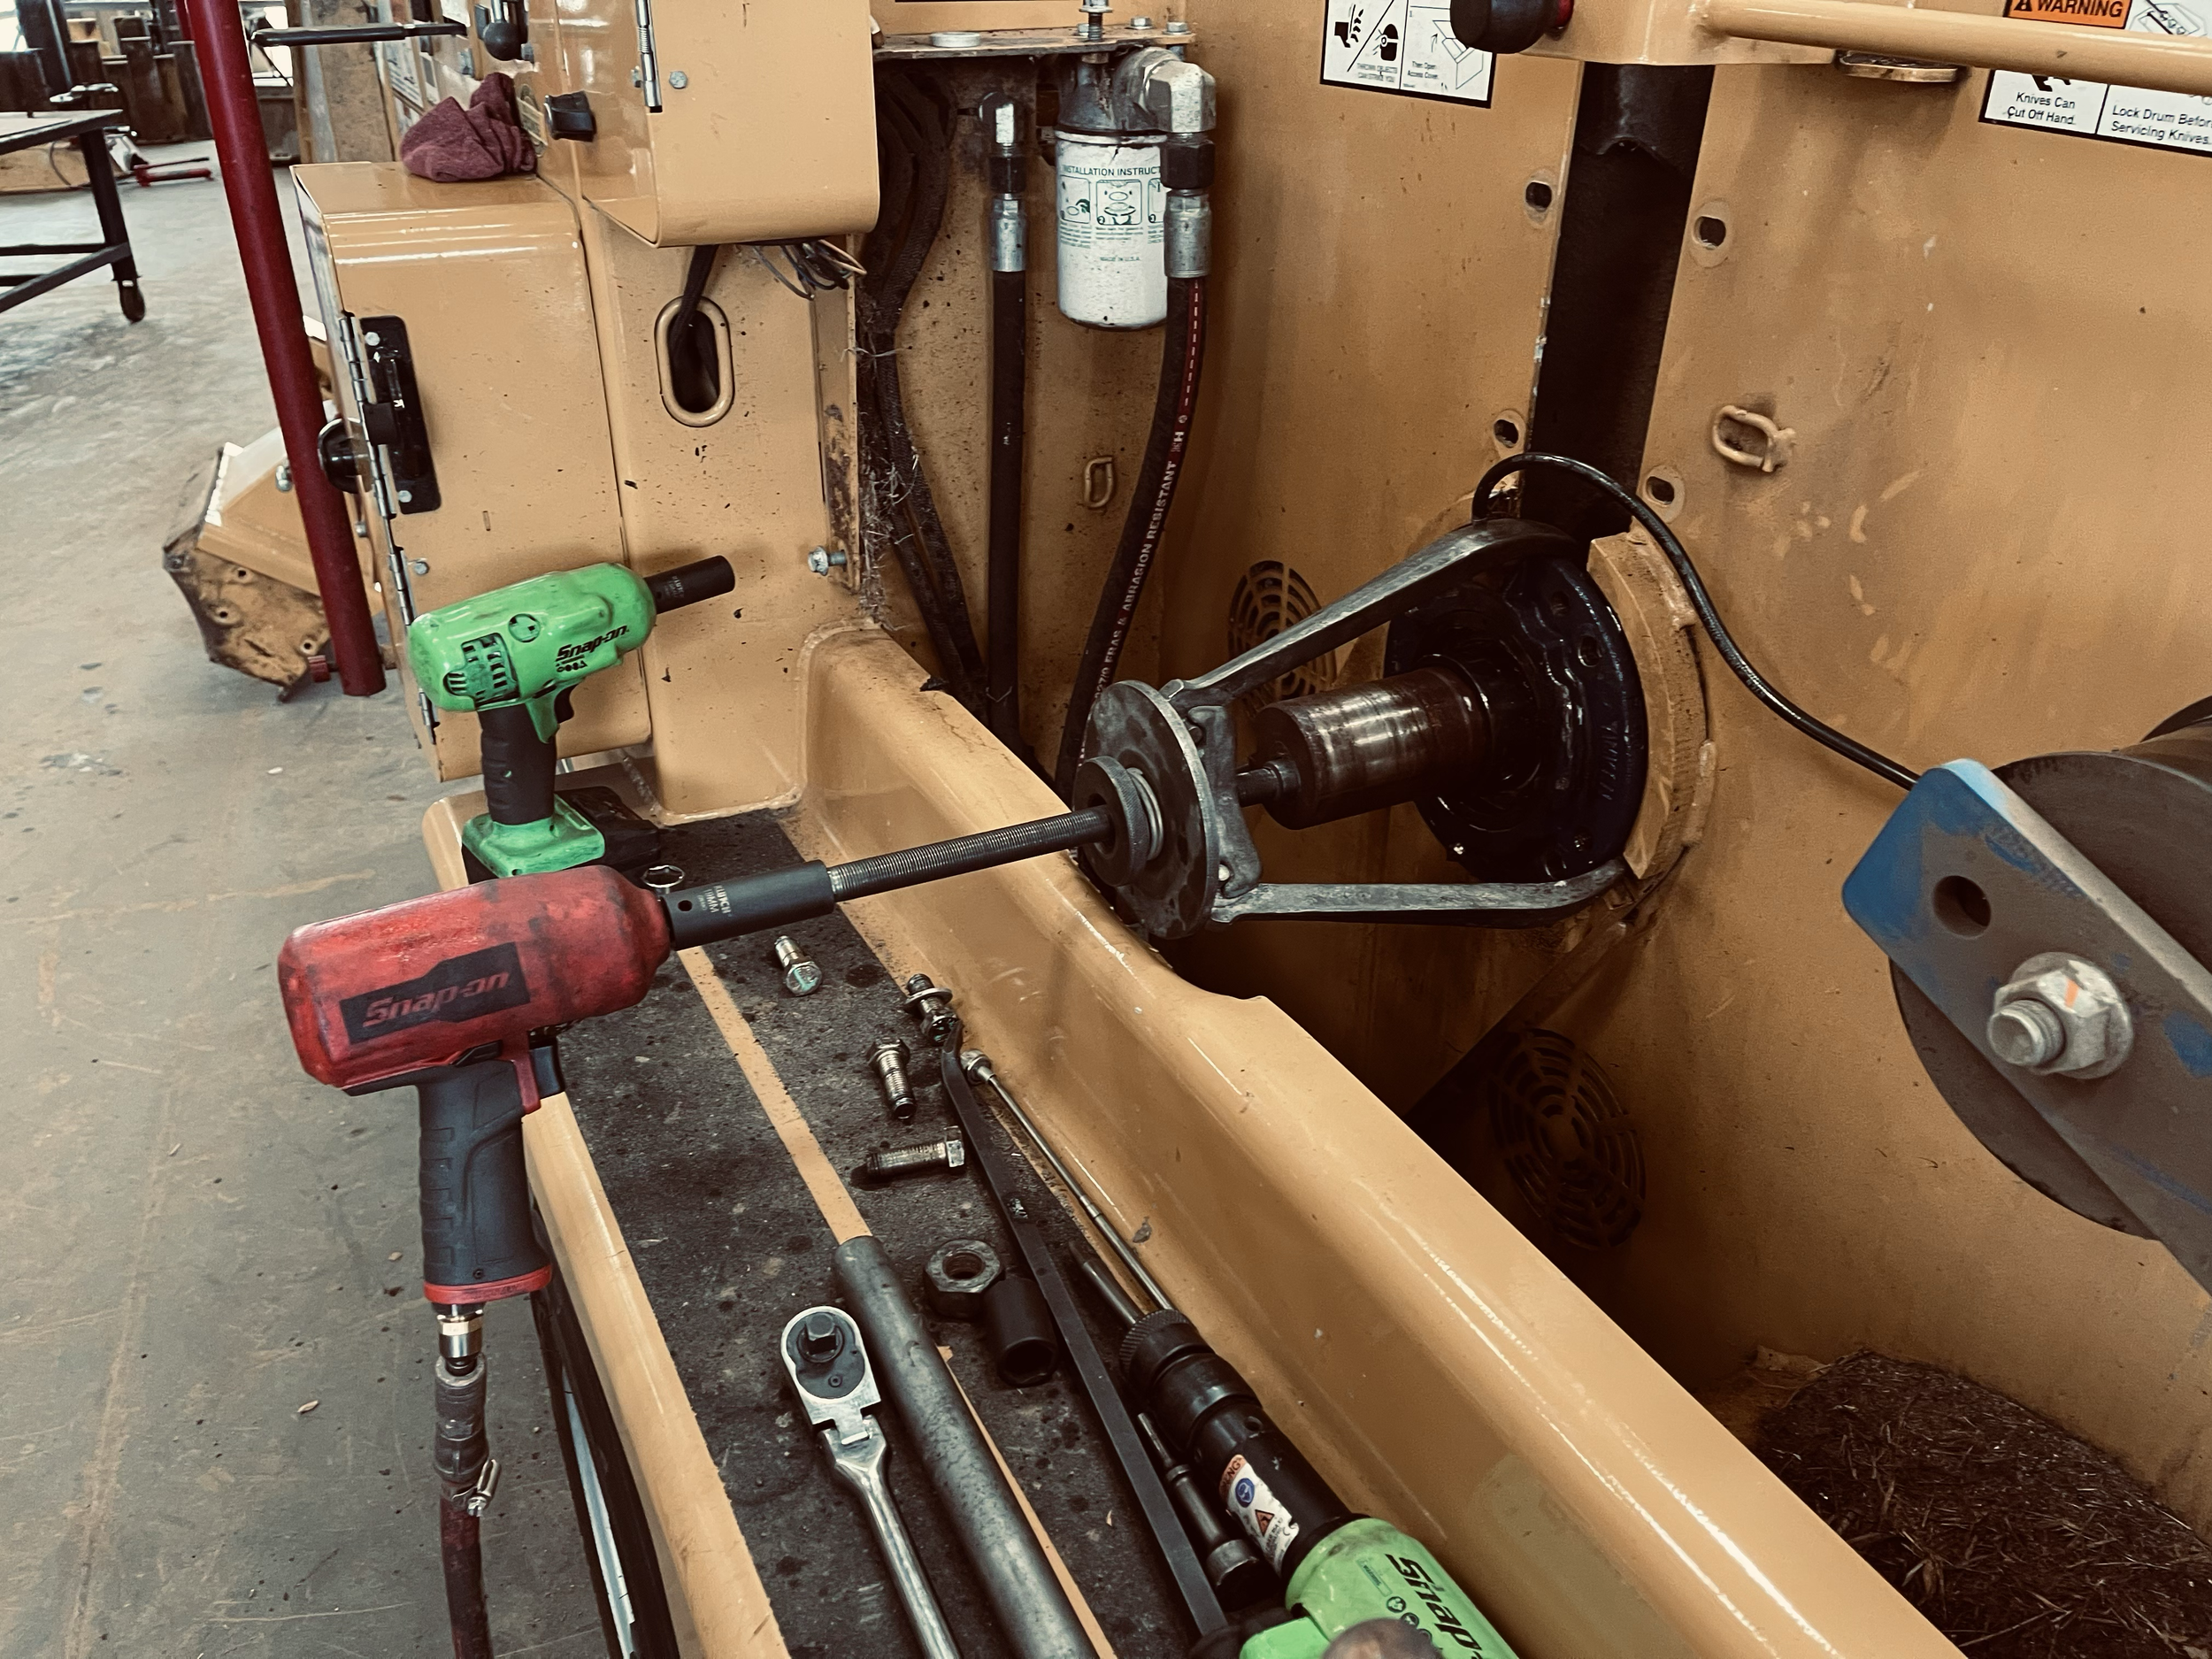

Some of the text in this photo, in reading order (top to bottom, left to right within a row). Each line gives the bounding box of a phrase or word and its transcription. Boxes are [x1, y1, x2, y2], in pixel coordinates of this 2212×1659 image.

[2038, 0, 2124, 18] WARNING
[2016, 91, 2076, 109] Knives Can
[2007, 105, 2025, 119] Cut
[2028, 109, 2045, 120] Off
[2112, 104, 2212, 128] Lock Drum Befor
[2111, 120, 2165, 141] Servicing
[1121, 543, 1152, 612] ABRASION
[1146, 460, 1177, 540] RESISTANT
[555, 625, 629, 662] Snap-on
[363, 972, 510, 1028] Snap-on
